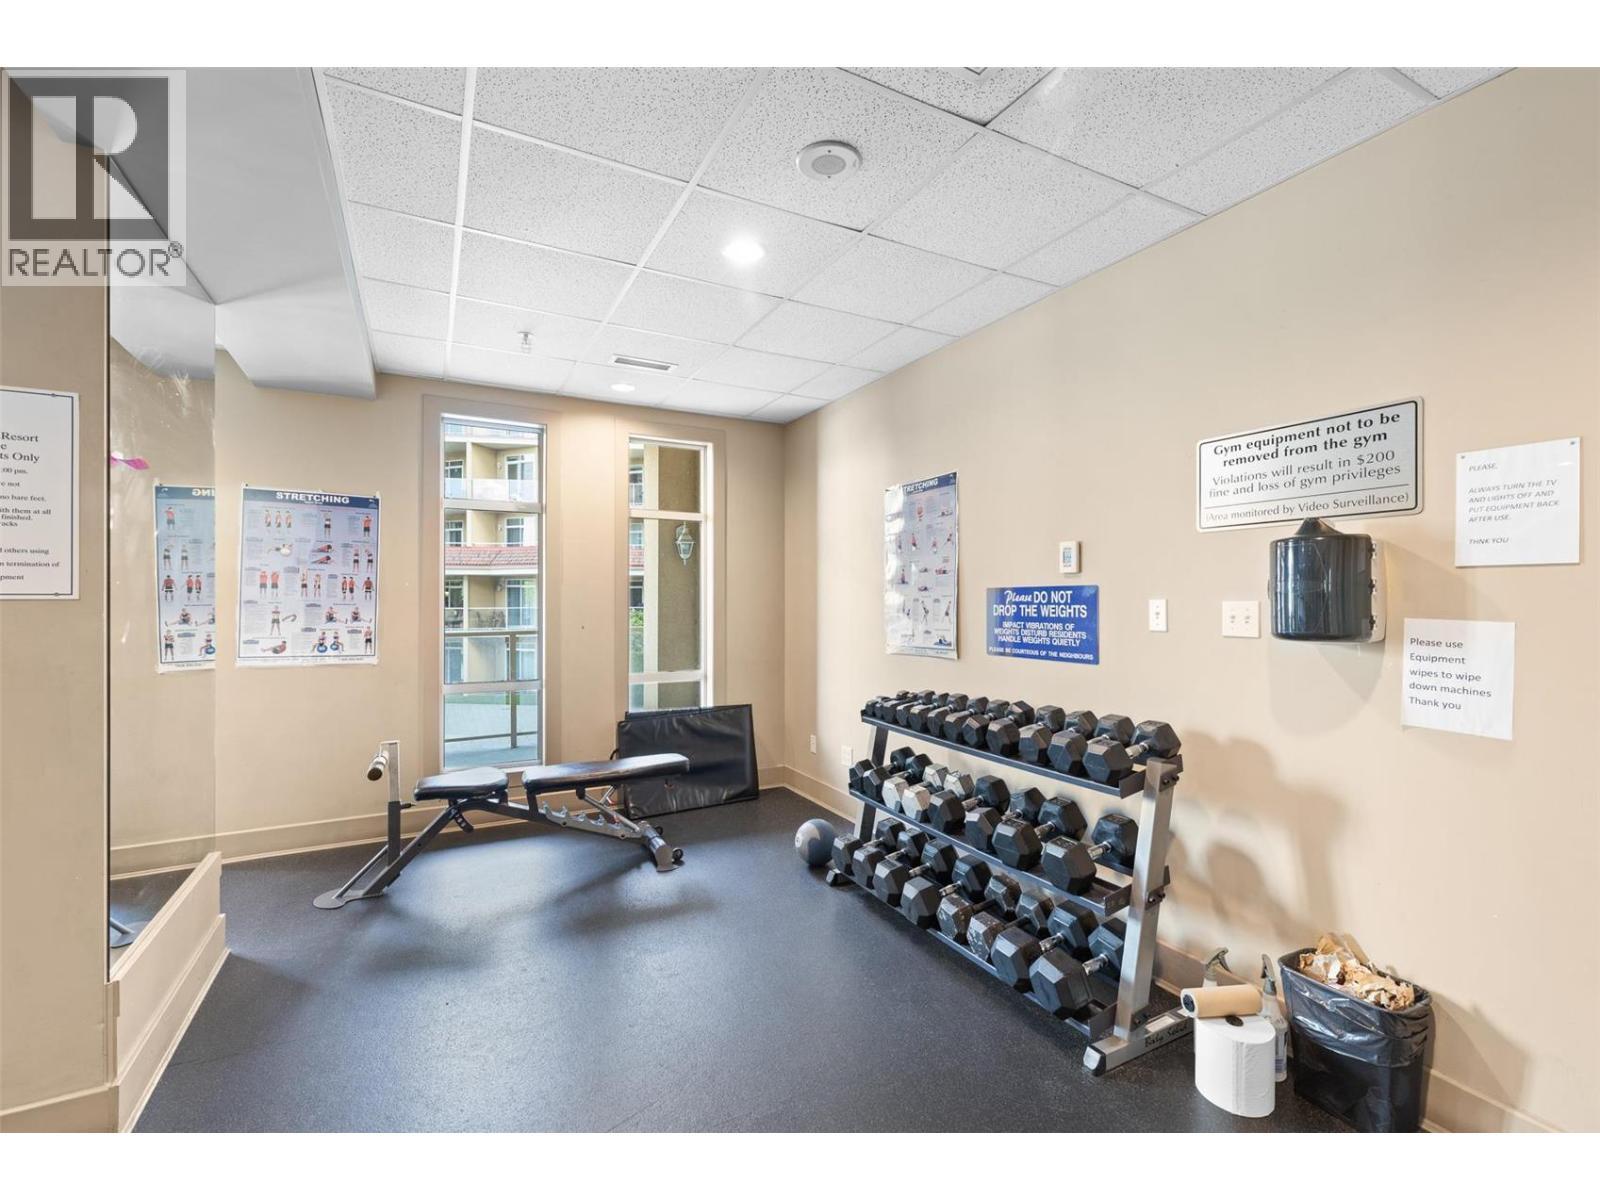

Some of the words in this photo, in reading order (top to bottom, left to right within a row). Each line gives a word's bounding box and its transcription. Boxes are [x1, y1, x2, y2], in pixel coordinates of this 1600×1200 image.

[1, 431, 39, 442] Resort
[1214, 443, 1241, 457] Gym
[1247, 427, 1320, 451] equipment
[1326, 421, 1351, 435] not
[1357, 418, 1373, 429] to
[1380, 413, 1400, 424] be
[1223, 448, 1279, 467] removed
[1284, 444, 1318, 457] from
[1323, 438, 1348, 450] the
[1353, 432, 1387, 449] gym
[12, 452, 40, 464] Only
[1213, 471, 1268, 486] Violations
[1271, 464, 1293, 477] will
[1297, 460, 1333, 474] result
[1338, 457, 1351, 468] in
[1357, 450, 1395, 465] $200
[1209, 488, 1230, 498] fine
[1233, 483, 1254, 495] and
[1258, 482, 1280, 492] loss
[1283, 476, 1297, 488] of
[1299, 475, 1327, 489] gym
[1332, 465, 1401, 485] privileges
[1468, 485, 1500, 494] ALWAYS
[1503, 482, 1525, 490] TURN
[1527, 480, 1543, 489] THE
[276, 491, 350, 505] STRETCHING
[1487, 494, 1515, 502] LIGHTS
[1516, 491, 1533, 499] OFF
[1534, 490, 1555, 498] AND
[1231, 505, 1280, 519] monitored
[1283, 504, 1295, 514] by
[1298, 501, 1330, 513] Video
[1333, 492, 1409, 509] Surveillance)
[1485, 502, 1534, 512] EQUIPMENT
[1536, 500, 1559, 508] BACK
[1004, 590, 1032, 604] Please
[1033, 591, 1048, 603] DO
[1050, 590, 1073, 603] NOT
[993, 604, 1018, 617] DROP
[1019, 604, 1038, 617] THE
[1040, 605, 1088, 618] WEIGHTS
[994, 627, 1020, 635] WEIGHTS
[1020, 628, 1048, 637] DISTURB
[1048, 630, 1087, 640] RESIDENTS
[1025, 622, 1063, 630] VIBRATIONS
[1065, 623, 1075, 631] OF
[1022, 636, 1051, 645] WEIGHTS
[1052, 638, 1081, 647] QUIETLY
[1410, 637, 1442, 648] Please
[1445, 640, 1464, 648] use
[1409, 653, 1466, 665] Equipment
[1409, 668, 1439, 678] wipes
[1441, 671, 1453, 680] to
[1455, 672, 1482, 682] wipe
[1409, 682, 1437, 692] down
[1440, 686, 1492, 698] machines
[1409, 696, 1440, 708] Thank
[1442, 701, 1462, 710] you
